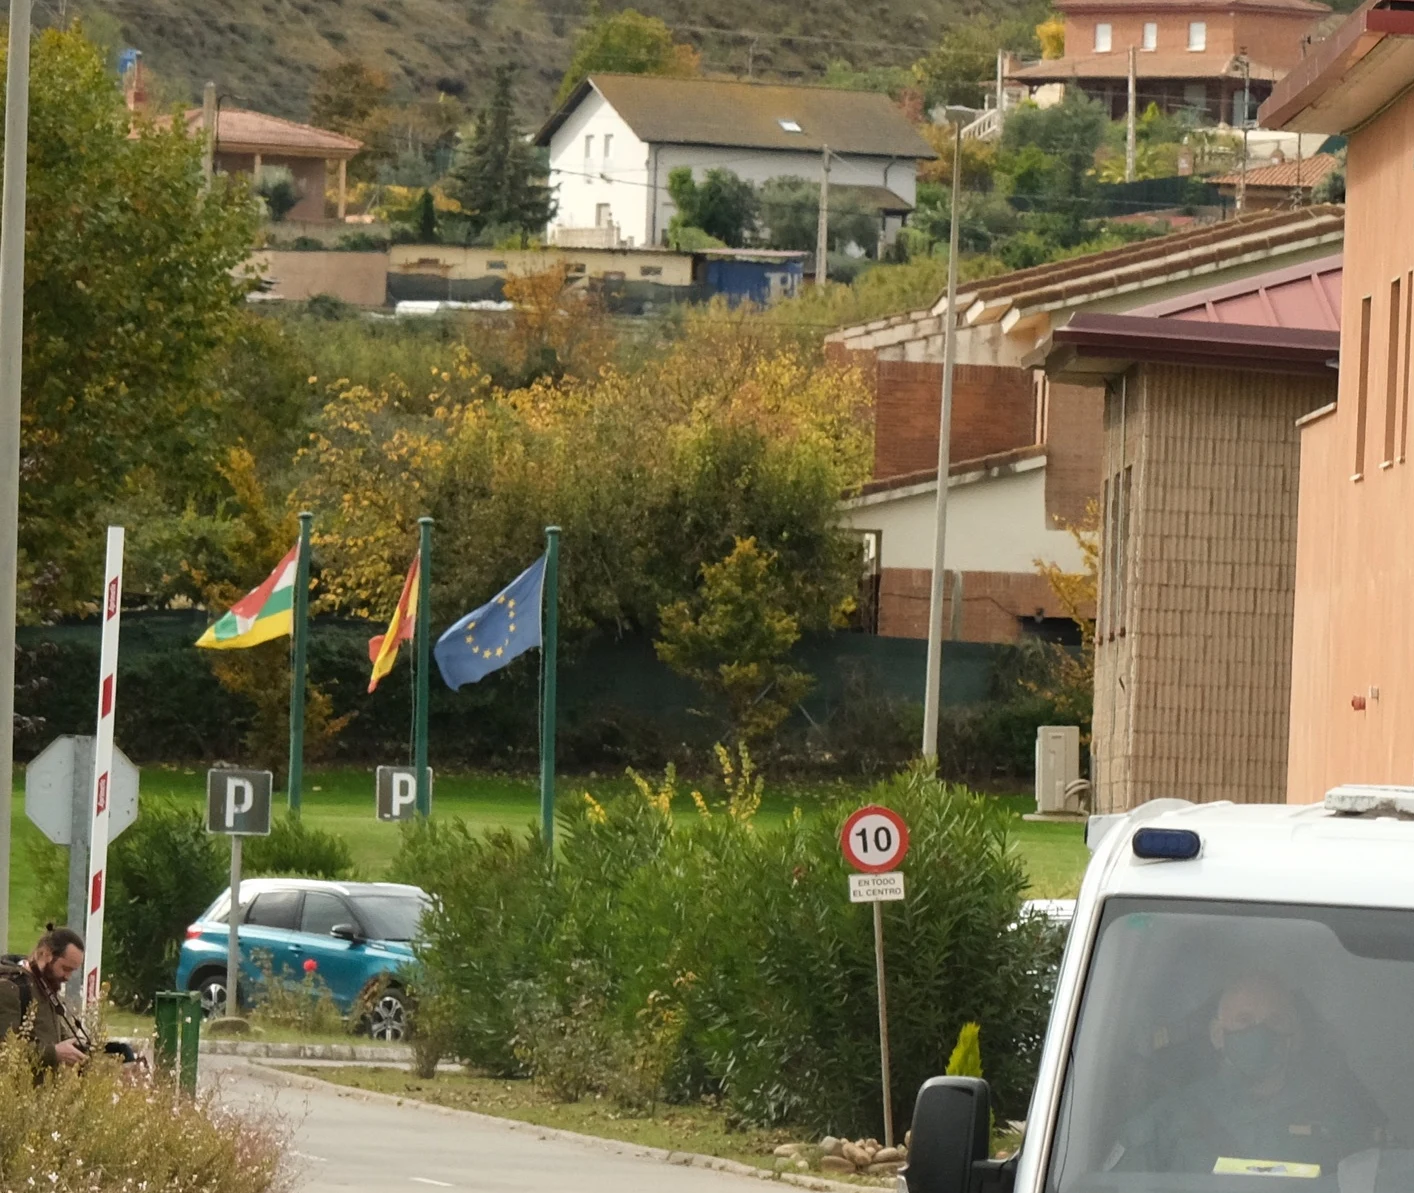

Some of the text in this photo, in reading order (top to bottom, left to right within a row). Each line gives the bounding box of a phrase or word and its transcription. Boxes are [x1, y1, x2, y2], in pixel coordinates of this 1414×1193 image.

[226, 776, 254, 828] P
[392, 772, 416, 817] P
[855, 826, 892, 853] 10
[858, 878, 896, 887] EN TODO
[866, 887, 901, 896] CENTRO
